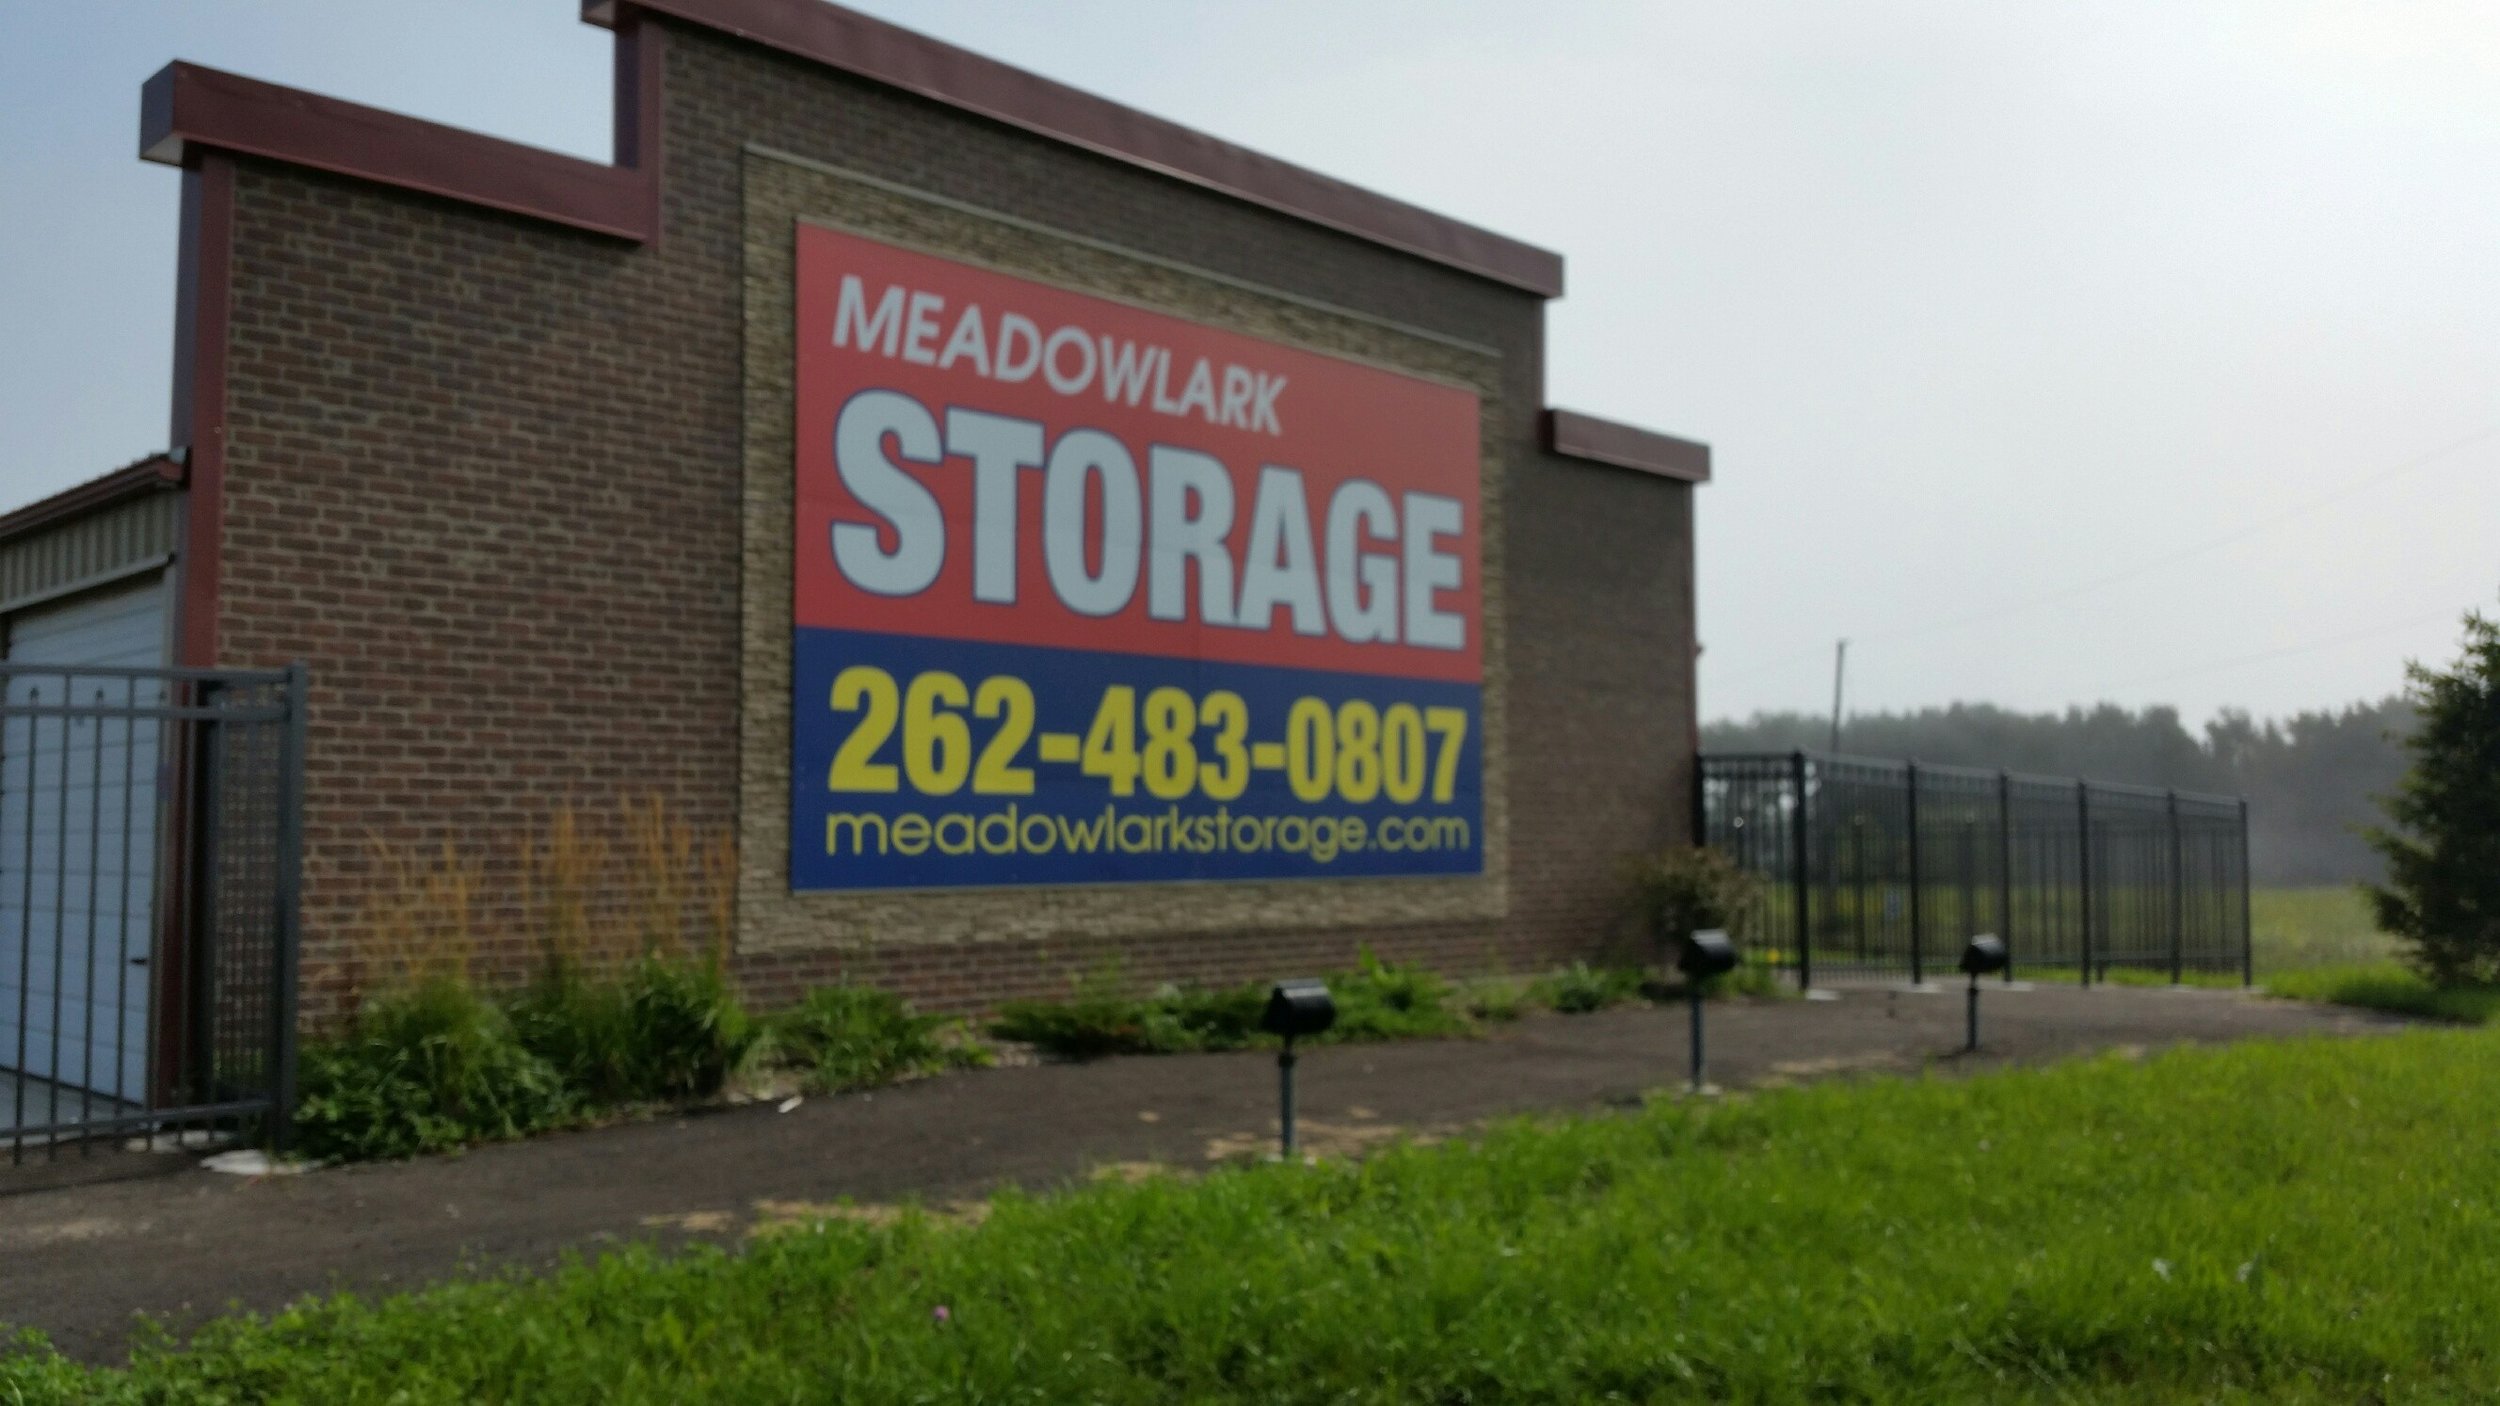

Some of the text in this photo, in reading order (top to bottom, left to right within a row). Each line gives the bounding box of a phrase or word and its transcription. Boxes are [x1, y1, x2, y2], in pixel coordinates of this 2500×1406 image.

[832, 274, 1288, 436] MEADOWLARK
[831, 388, 1466, 651] STORAGE
[828, 665, 1468, 802] 262-483-0807
[826, 804, 1470, 862] meadowlarkstorage.com
